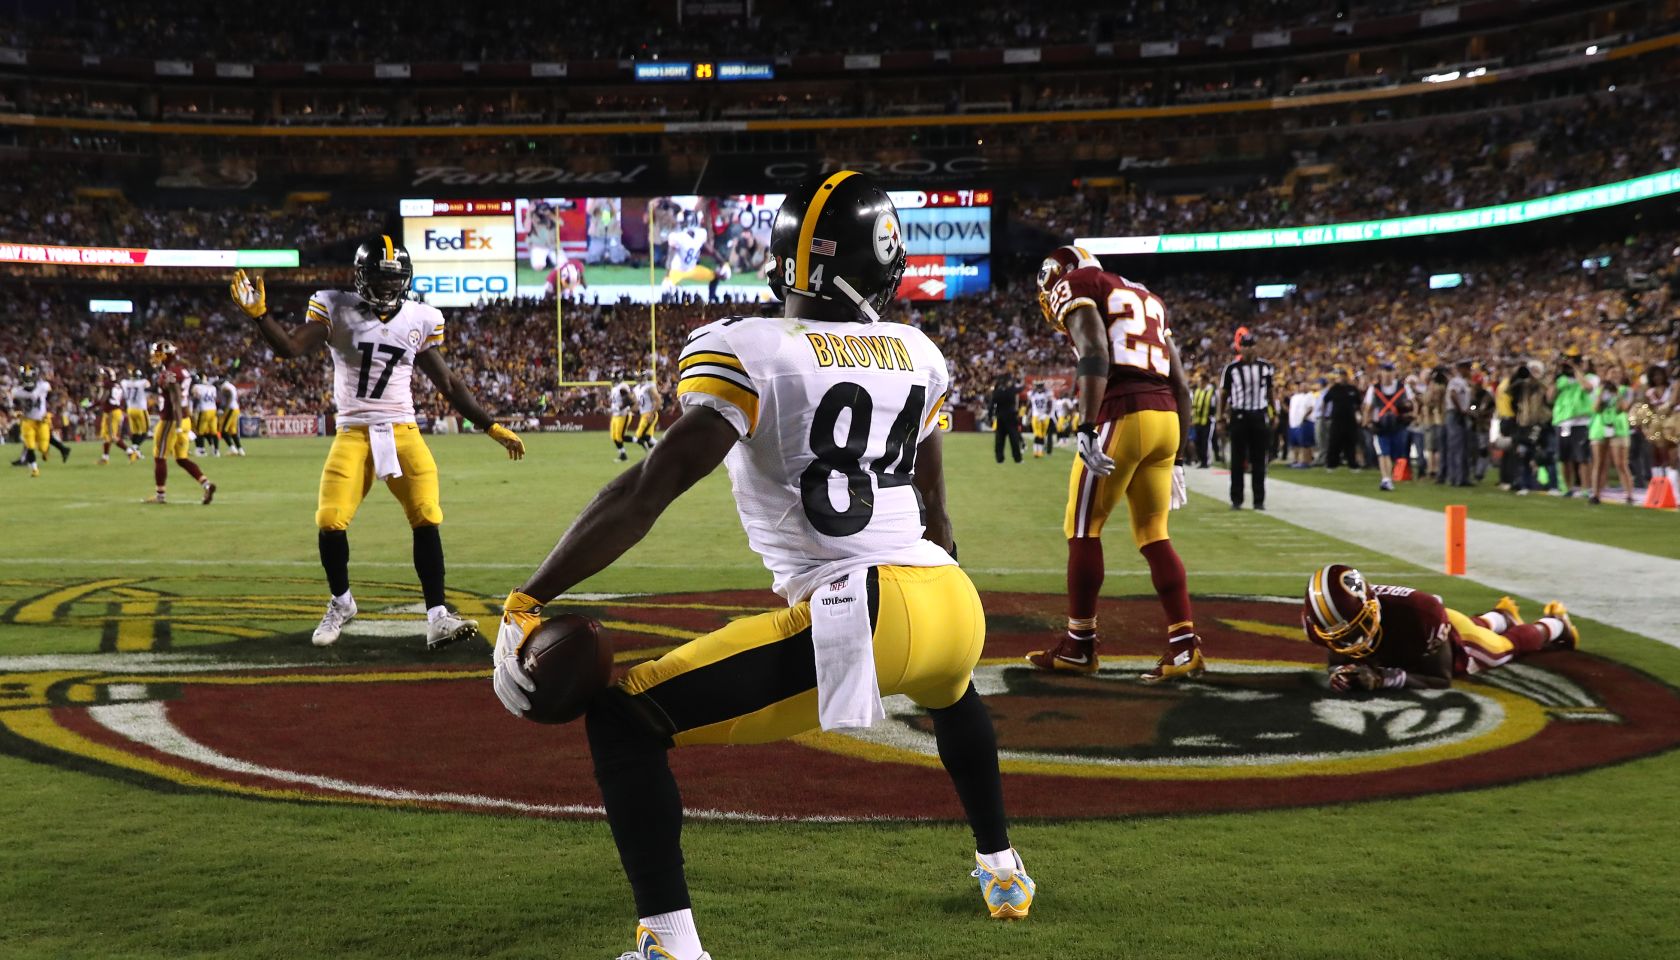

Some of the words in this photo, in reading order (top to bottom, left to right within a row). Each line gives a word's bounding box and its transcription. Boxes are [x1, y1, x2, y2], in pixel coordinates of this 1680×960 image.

[696, 63, 712, 78] 25
[412, 164, 648, 187] FanDuel
[425, 229, 493, 251] FedEx
[906, 221, 986, 242] INOVA
[785, 257, 824, 291] 84
[931, 263, 979, 277] America
[412, 276, 508, 294] GEICO
[1107, 288, 1171, 378] 23
[805, 333, 914, 371] BROWN
[356, 341, 407, 399] 17
[265, 418, 315, 434] KICKOFF
[800, 381, 926, 538] 84
[821, 596, 853, 606] Wilson
